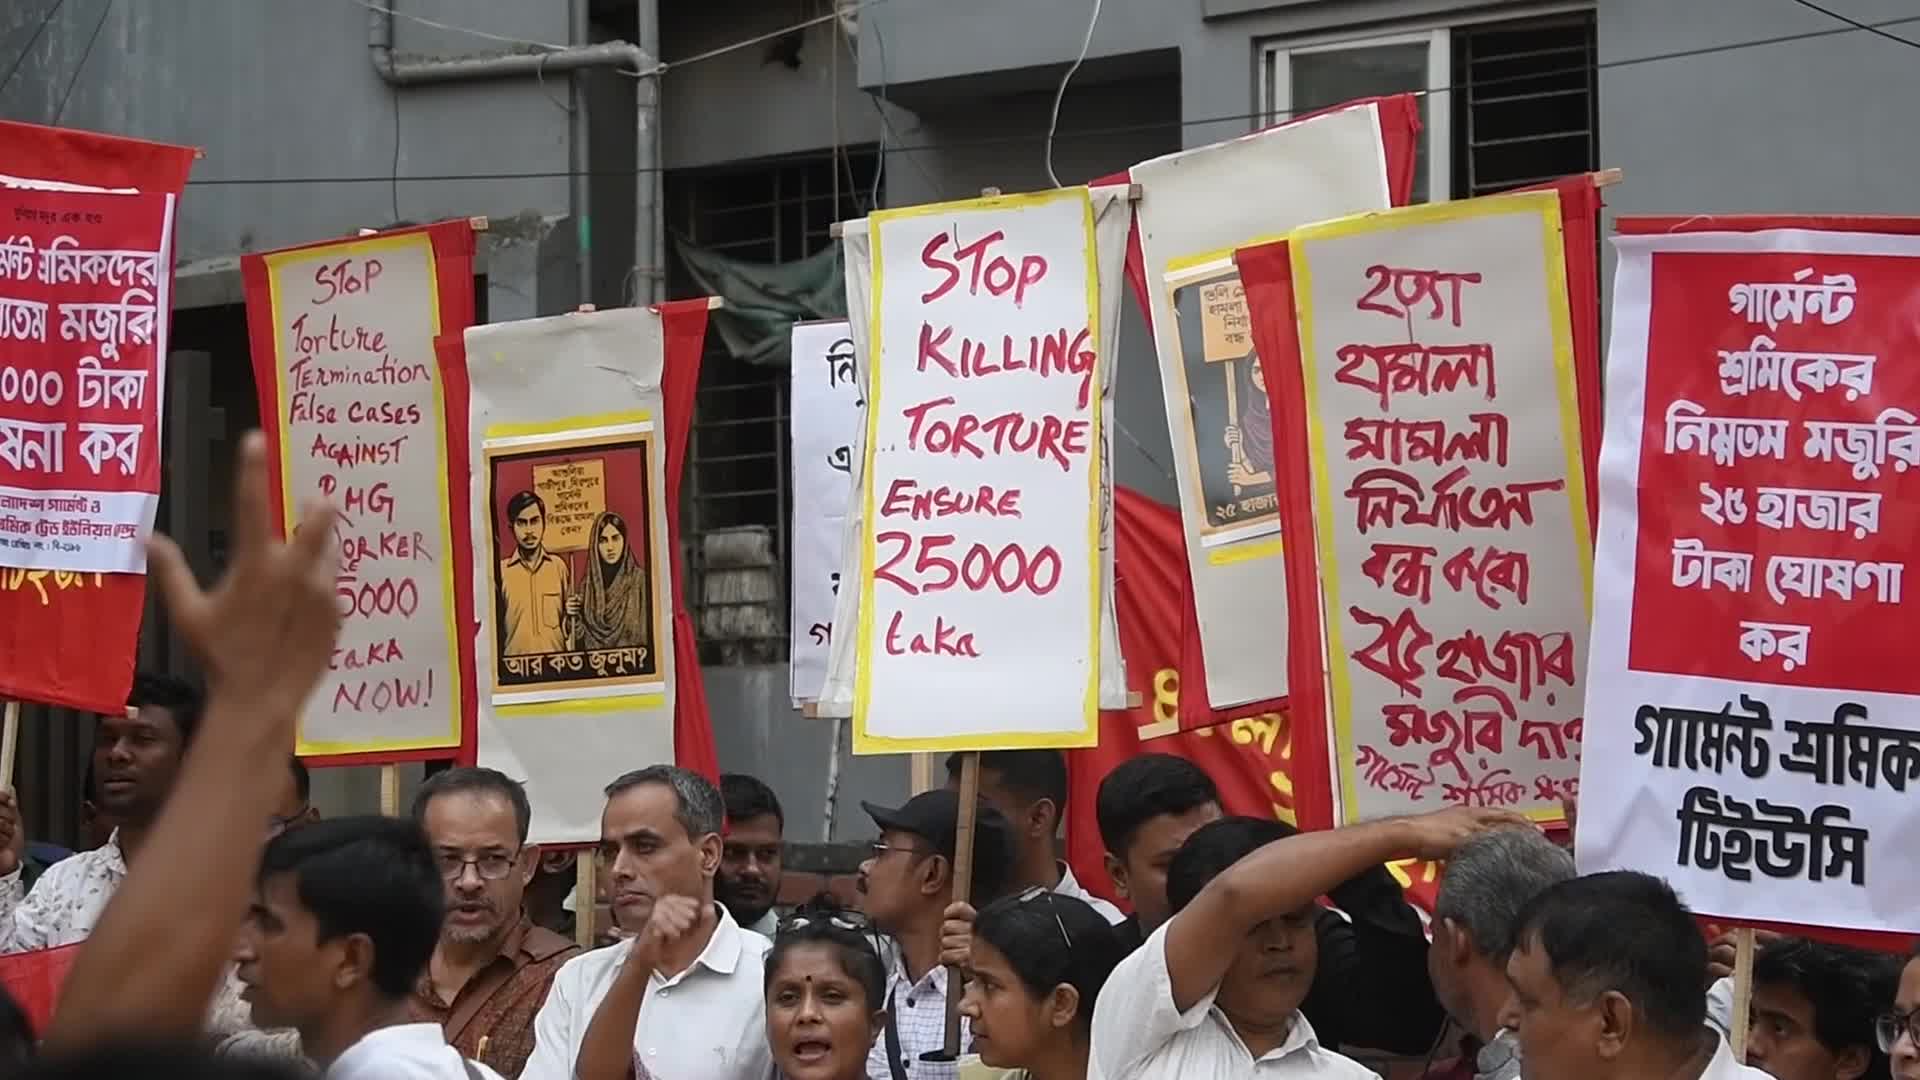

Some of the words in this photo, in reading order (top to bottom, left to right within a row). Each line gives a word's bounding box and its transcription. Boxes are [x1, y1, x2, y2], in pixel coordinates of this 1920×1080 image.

[37, 235, 160, 287] শ্রমিকদের
[312, 259, 382, 304] STOP
[922, 230, 1048, 309] STOP
[58, 288, 157, 362] মজুরি
[1357, 265, 1482, 327] হত্যা
[1728, 267, 1857, 332] গার্মেন্ট
[291, 313, 386, 354] Torture
[77, 356, 148, 410] টাকা
[917, 321, 1096, 409] KILLING
[1335, 344, 1496, 412] হামলা
[1717, 335, 1877, 401] শ্রমিকের
[78, 423, 144, 475] কর
[903, 396, 1090, 472] TORTURE
[1344, 413, 1508, 467] মামলা
[1664, 399, 1790, 467] নিম্নতম
[1803, 408, 1920, 480] মজুরি
[35, 518, 60, 538] ট্রেড
[62, 519, 113, 541] ইউনিয়ন
[91, 500, 101, 513] ও
[881, 479, 1022, 521] ENSURE
[1240, 495, 1279, 512] হাজা
[1700, 482, 1748, 526] ২৫
[1755, 487, 1882, 540] হাজার
[334, 525, 433, 562] ORKER
[873, 531, 1062, 595] 25000
[1671, 538, 1754, 594] টাকা
[1765, 555, 1904, 606] ঘোষণা
[335, 573, 418, 619] 5000
[1361, 543, 1438, 604] বন্ধ
[1442, 546, 1529, 610] করো
[503, 656, 544, 677] আর
[549, 651, 584, 676] কত
[588, 646, 648, 677] জুলুম?
[1349, 605, 1434, 698] ২৫
[1436, 629, 1576, 706] হাজার
[1739, 621, 1811, 672] কর
[333, 668, 433, 714] NOW!
[1382, 685, 1518, 782] মজুরি
[1634, 694, 1773, 779] গার্মেন্ট
[1780, 702, 1920, 793] শ্রমিক
[1676, 786, 1871, 888] টিইউসি
